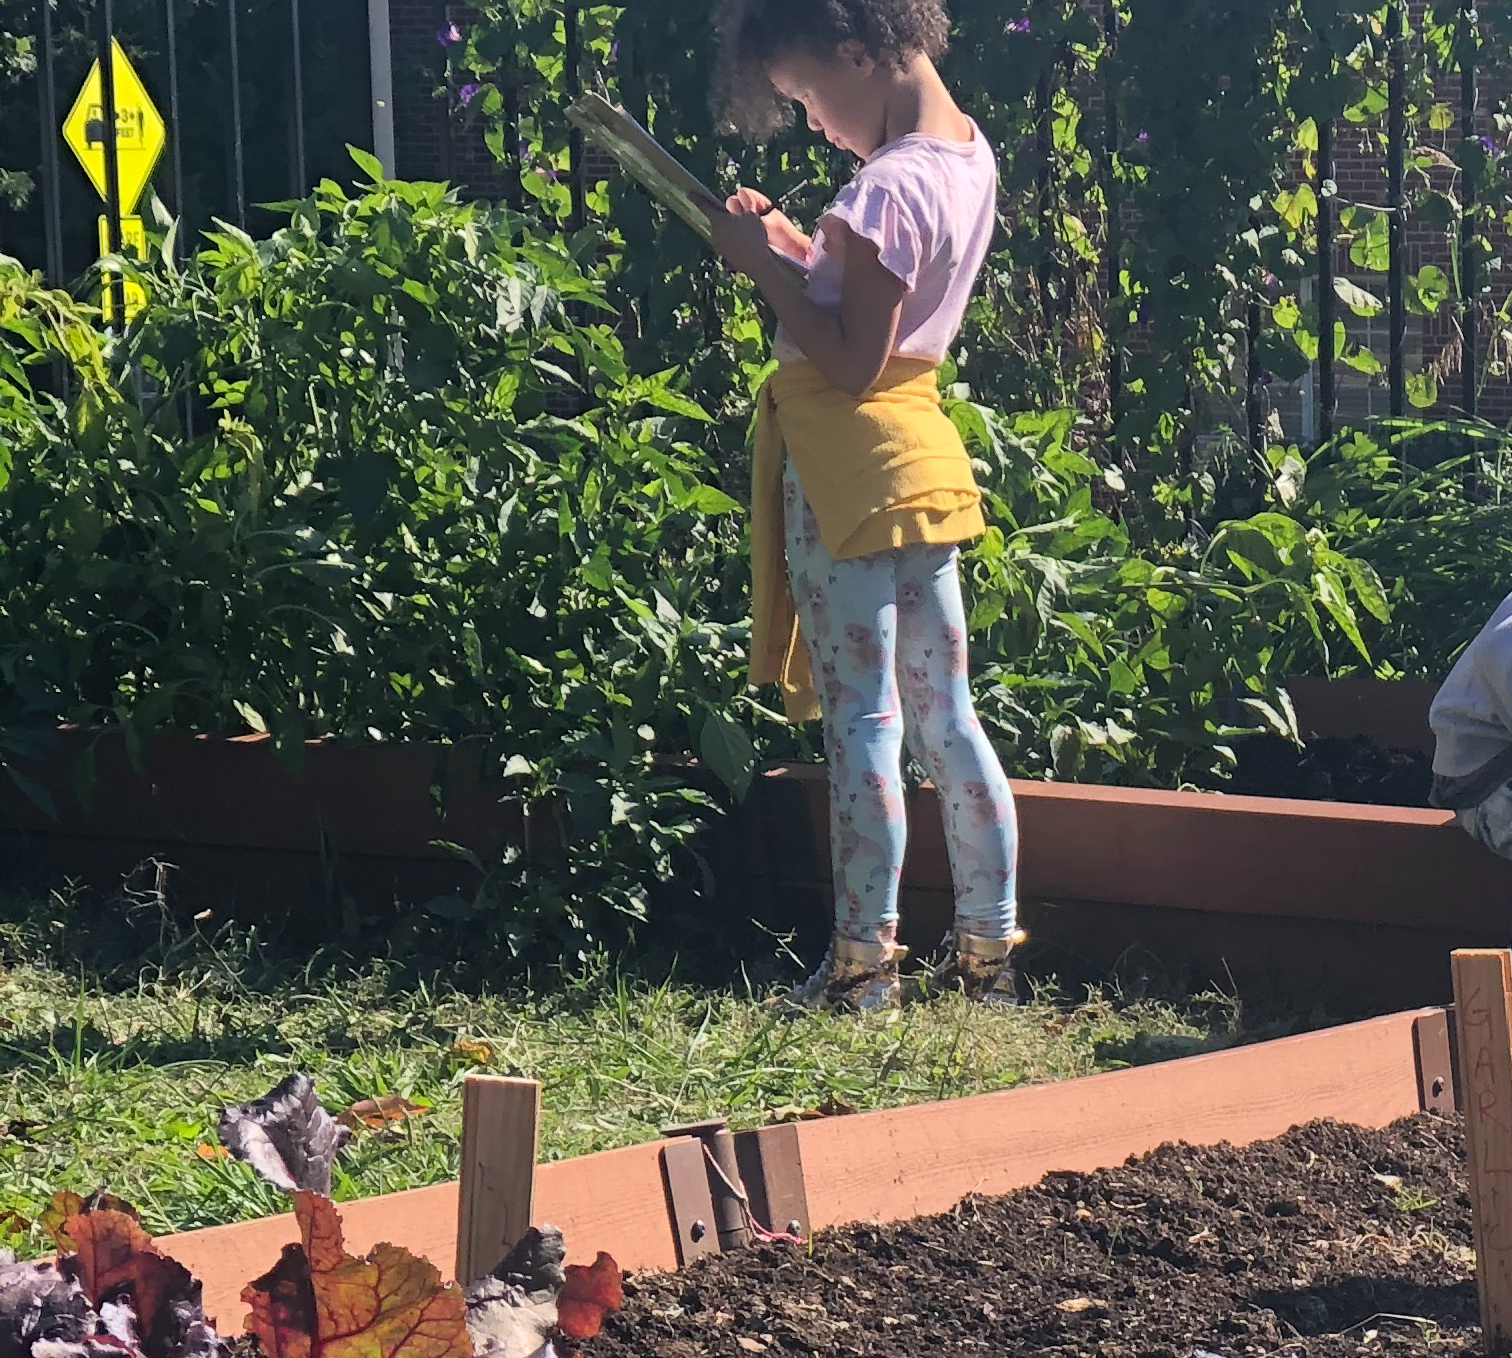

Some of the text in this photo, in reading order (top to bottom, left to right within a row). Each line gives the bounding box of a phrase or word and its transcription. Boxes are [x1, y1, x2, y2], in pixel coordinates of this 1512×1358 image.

[120, 107, 129, 124] 3
[115, 126, 135, 138] FEET
[1463, 987, 1512, 1251] GARLIC
